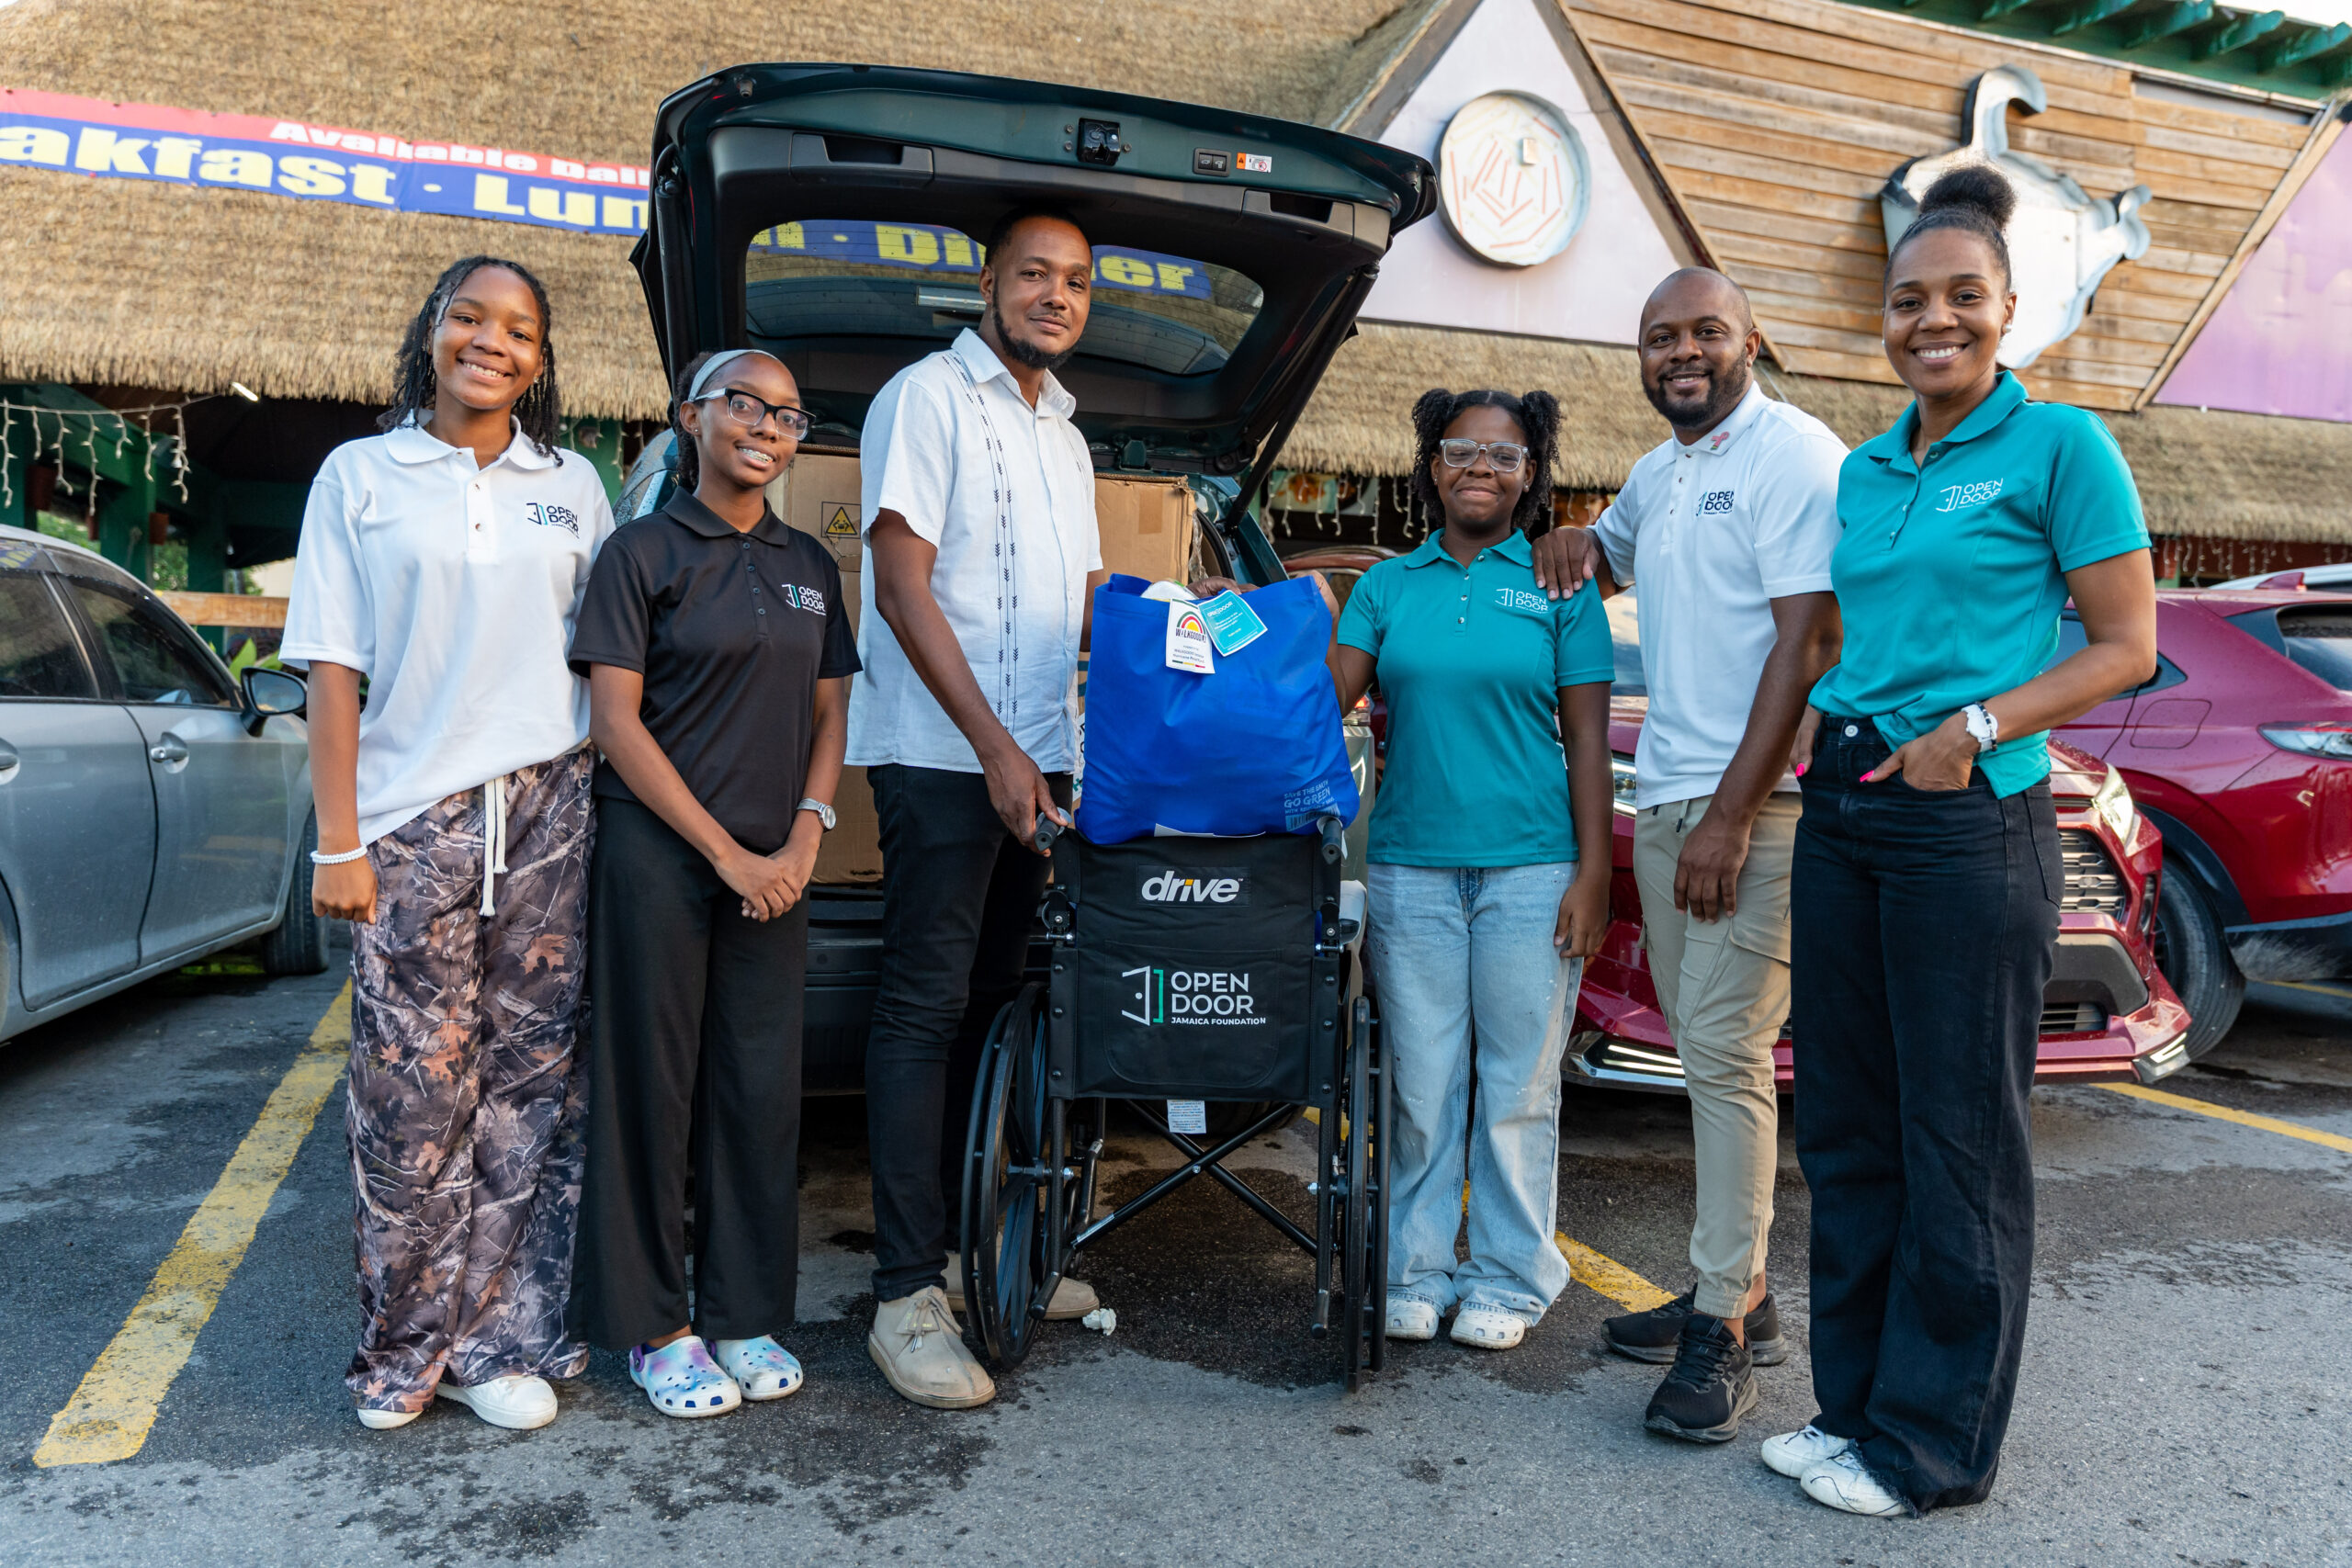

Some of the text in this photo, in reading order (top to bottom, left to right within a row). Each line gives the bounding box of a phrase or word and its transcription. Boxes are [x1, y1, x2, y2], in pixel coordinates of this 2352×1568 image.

[876, 224, 1193, 291] Dier
[1963, 478, 2004, 494] OPEN
[547, 505, 578, 523] OPEN
[548, 514, 579, 536] DOOR
[798, 586, 823, 602] OPEN
[1516, 591, 1546, 604] OPEN
[800, 595, 826, 612] DOOR
[1515, 598, 1549, 612] DOOR
[1283, 786, 1330, 808] GO GREEN
[1284, 791, 1302, 799] SAVE
[1303, 787, 1315, 796] THE
[1141, 870, 1240, 903] drive
[1170, 971, 1249, 993] OPEN
[1171, 993, 1254, 1015] DOOR
[1171, 1016, 1266, 1026] JAMAICA FOUNDATION
